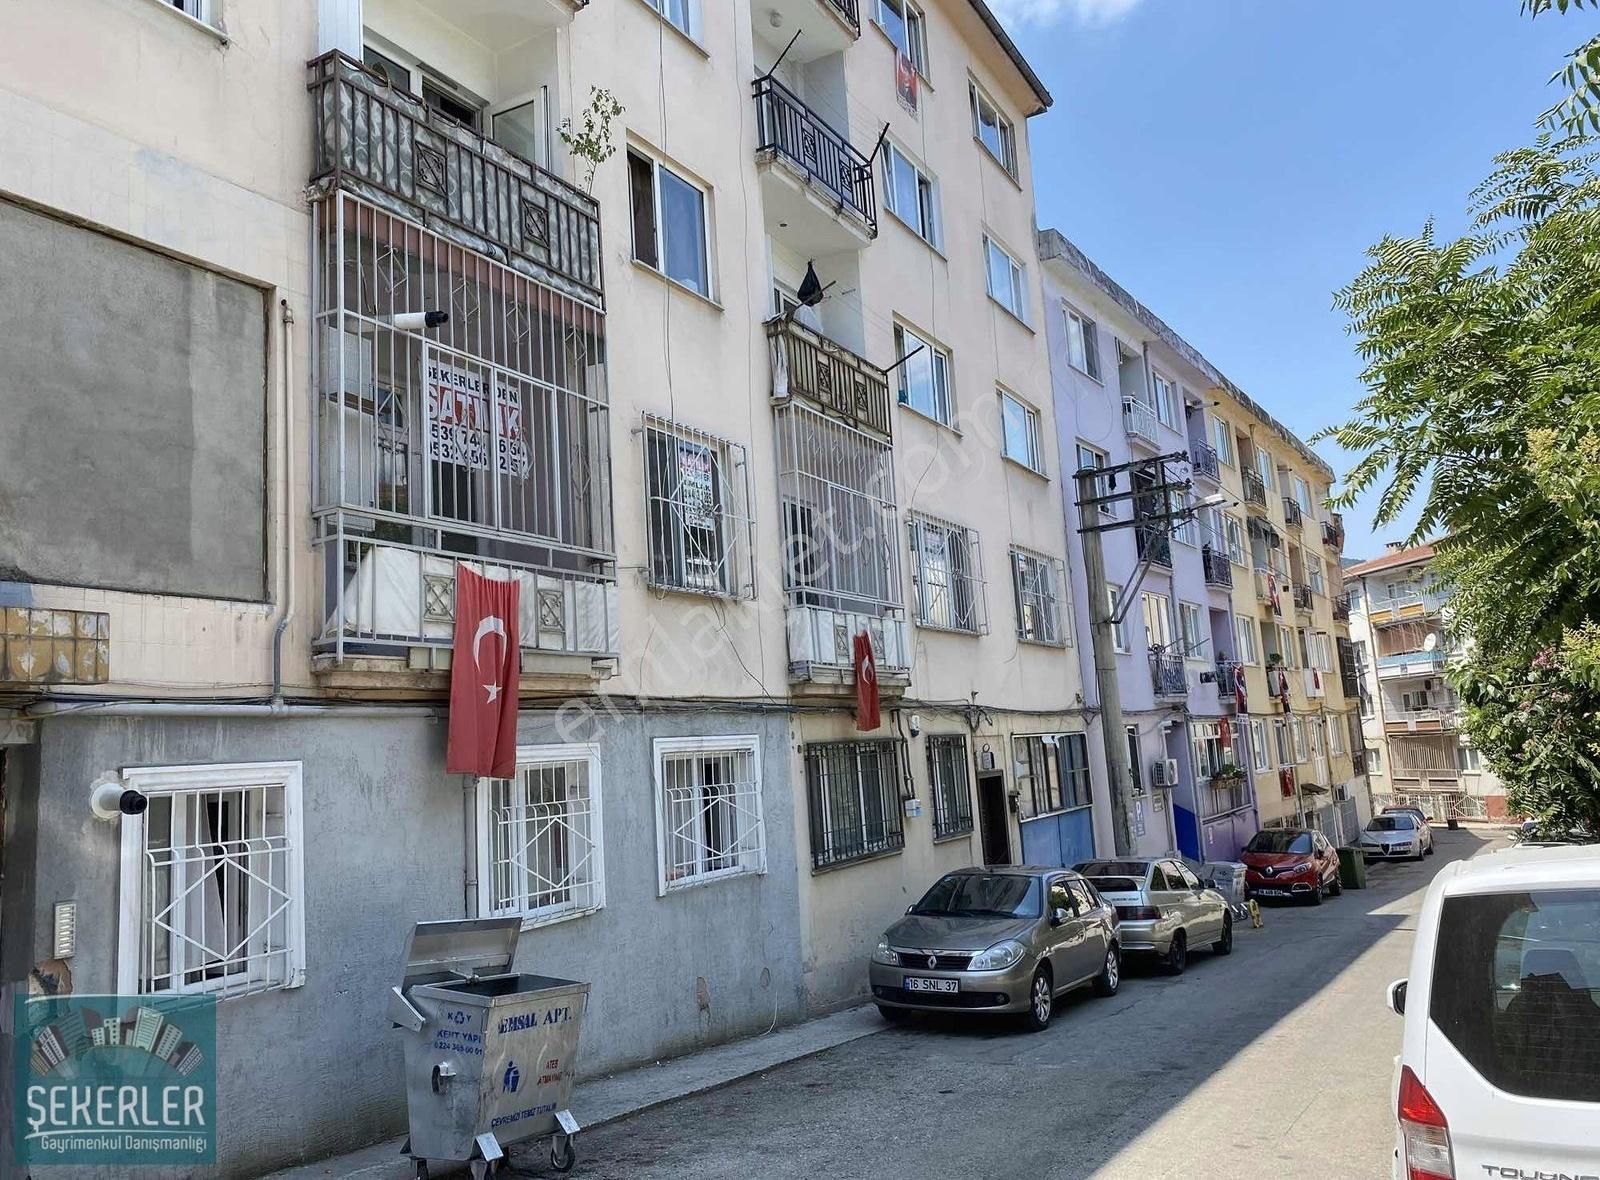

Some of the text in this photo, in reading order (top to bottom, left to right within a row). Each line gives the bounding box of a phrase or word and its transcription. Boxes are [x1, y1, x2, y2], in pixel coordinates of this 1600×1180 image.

[909, 978, 957, 991] 16 SNL 37
